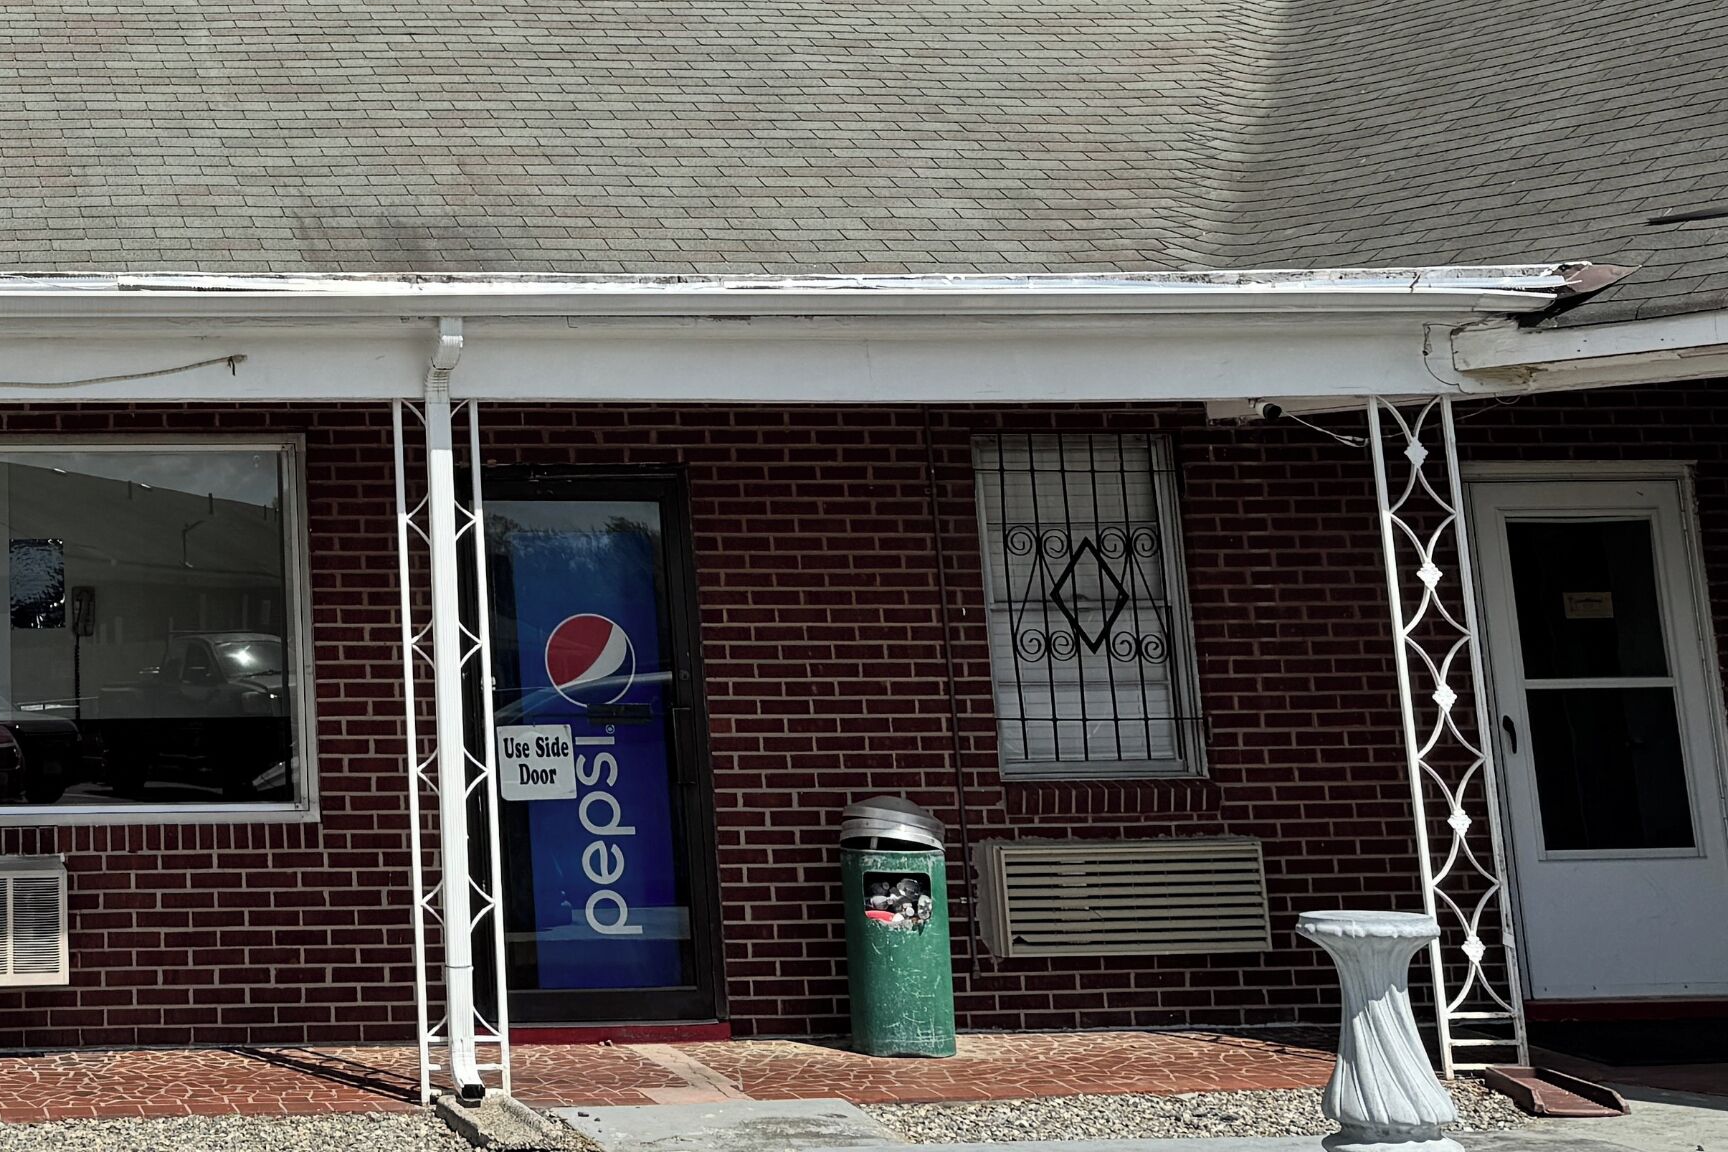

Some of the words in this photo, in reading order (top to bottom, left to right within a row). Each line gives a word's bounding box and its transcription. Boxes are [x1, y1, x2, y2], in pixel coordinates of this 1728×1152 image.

[502, 737, 530, 759] Use
[535, 736, 569, 758] Side
[518, 763, 557, 785] Door
[575, 736, 643, 935] pepsi
